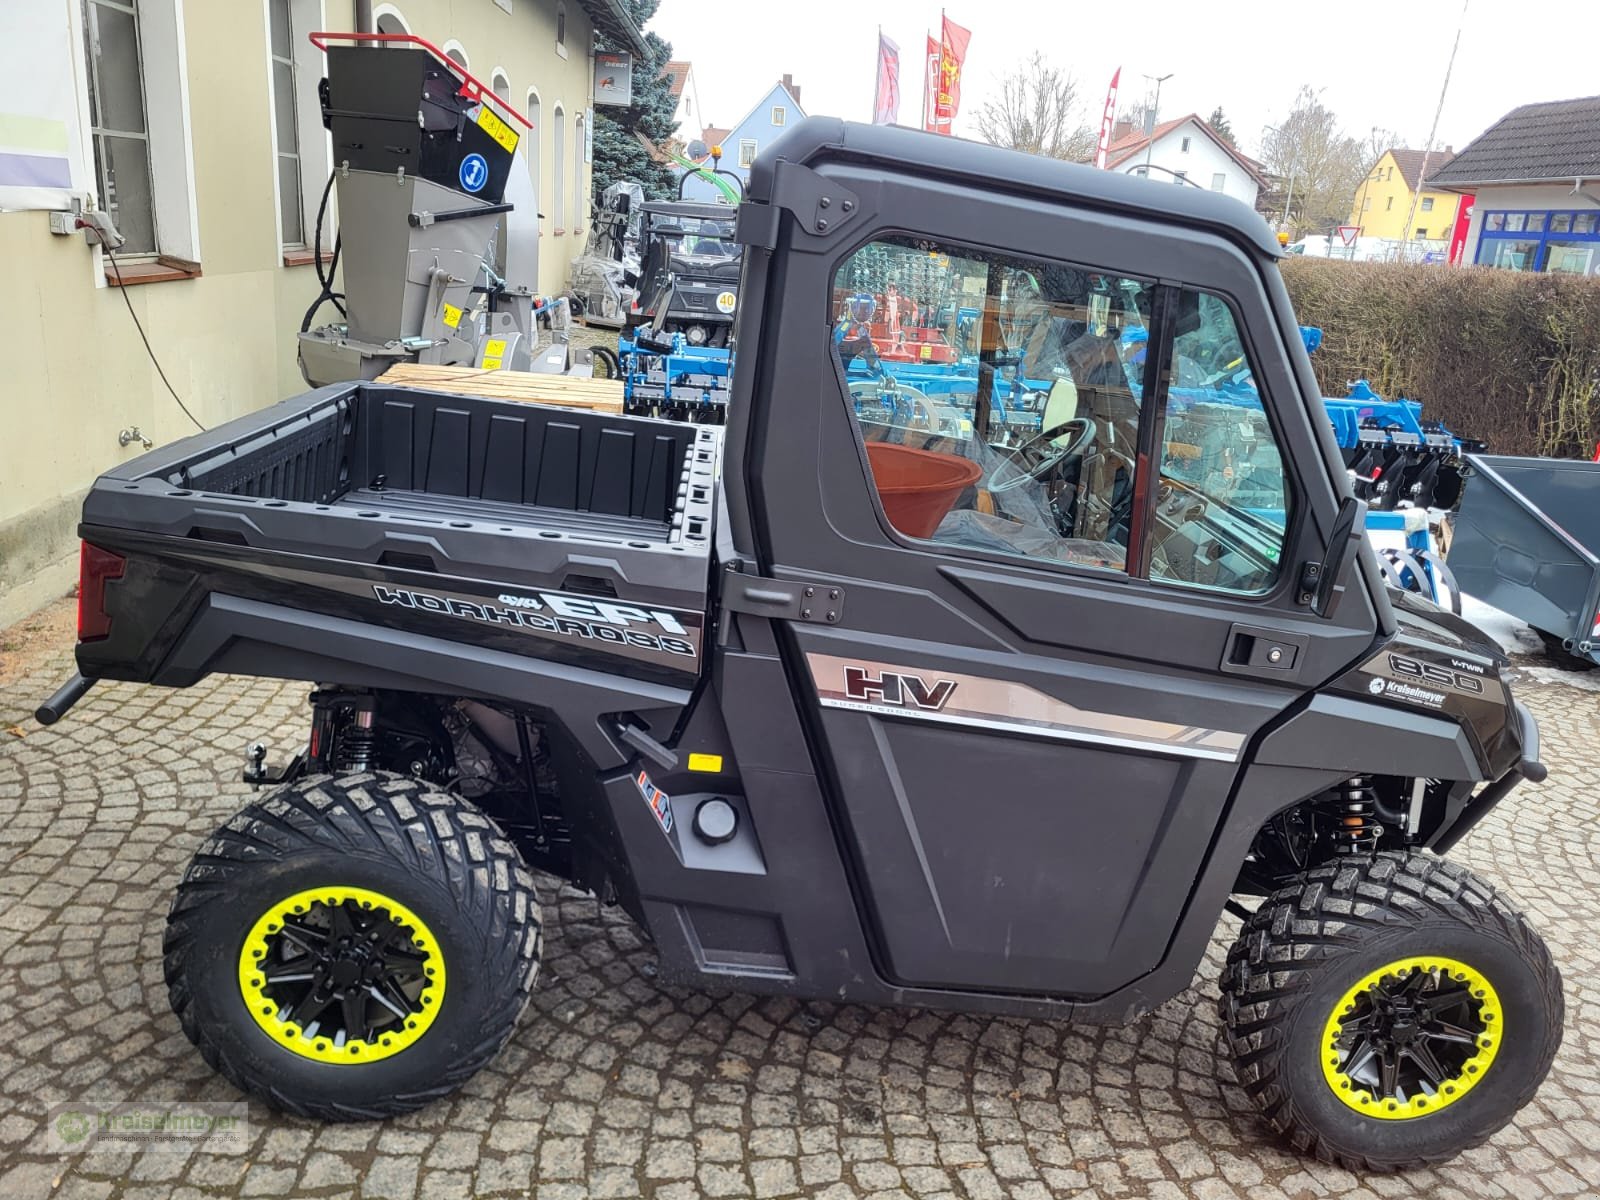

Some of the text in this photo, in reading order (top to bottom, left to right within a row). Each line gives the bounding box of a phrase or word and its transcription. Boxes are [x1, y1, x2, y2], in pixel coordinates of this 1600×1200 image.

[719, 295, 734, 306] 40
[372, 585, 697, 657] WORKCROSS
[539, 593, 688, 636] EFI
[843, 665, 958, 710] HV
[1388, 653, 1485, 696] 850
[1451, 659, 1484, 674] V-TWIN
[1386, 680, 1446, 703] Kreiselmeyer
